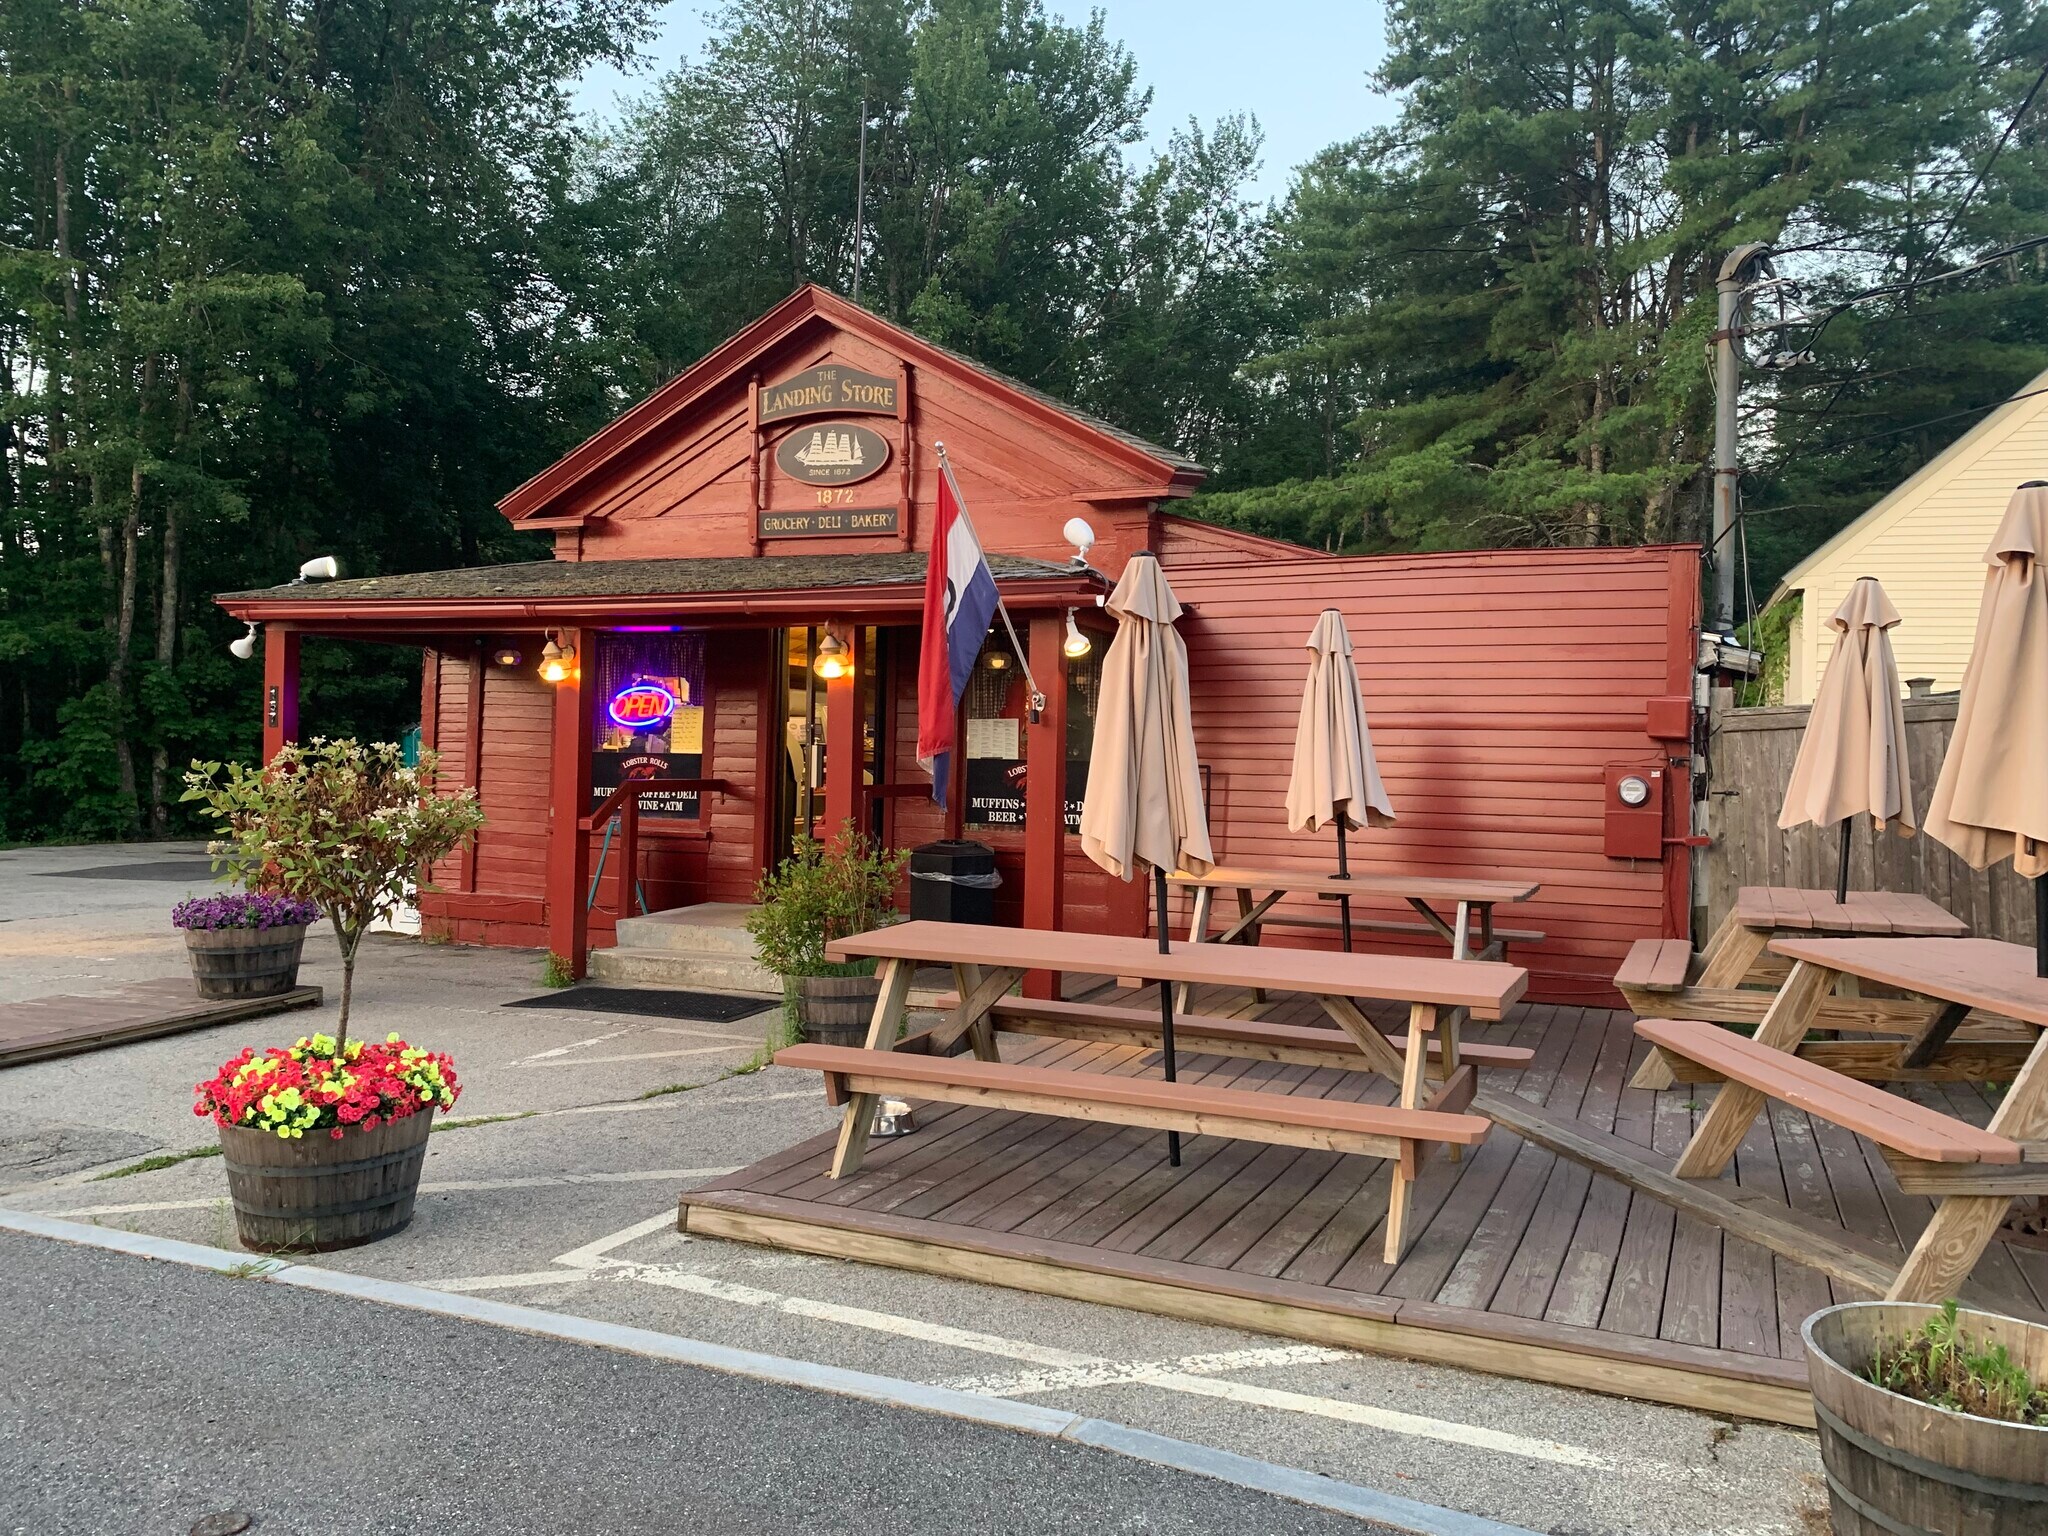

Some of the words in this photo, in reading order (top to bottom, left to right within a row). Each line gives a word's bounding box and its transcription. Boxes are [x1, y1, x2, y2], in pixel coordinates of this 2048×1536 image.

[817, 370, 837, 381] THE
[763, 385, 832, 415] LANDING
[841, 379, 893, 407] STORE
[808, 468, 830, 476] SINCE
[816, 489, 854, 504] 1872
[764, 517, 810, 531] GROCERY
[818, 516, 840, 529] DELI
[851, 513, 894, 528] BAKERY
[614, 694, 667, 717] OPEN
[622, 757, 648, 769] LOBSTER
[649, 757, 669, 770] ROLLS
[1008, 765, 1027, 777] LOBS
[594, 787, 617, 796] MUFF
[676, 791, 697, 800] DELI
[664, 801, 683, 811] ATM
[972, 798, 1019, 809] MUFFINS
[988, 811, 1017, 823] BEER
